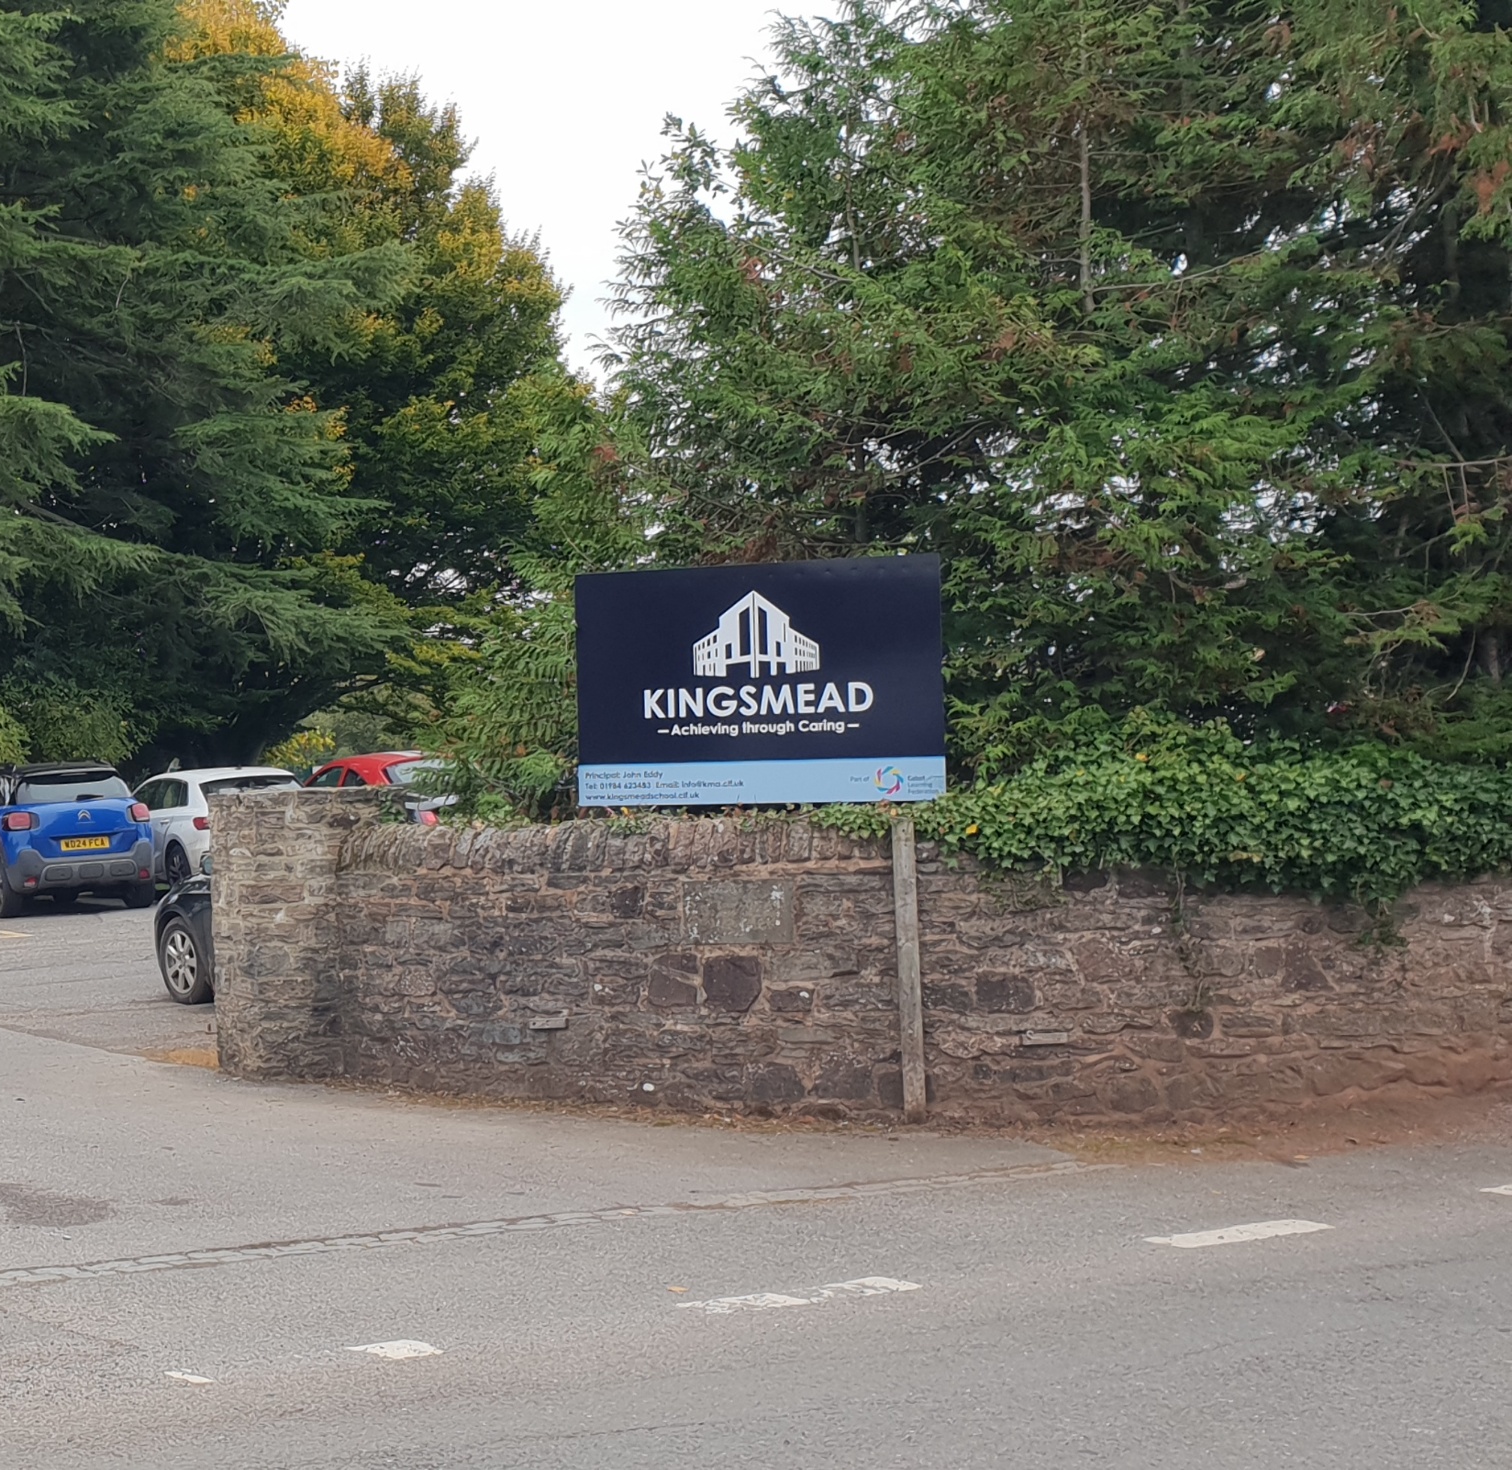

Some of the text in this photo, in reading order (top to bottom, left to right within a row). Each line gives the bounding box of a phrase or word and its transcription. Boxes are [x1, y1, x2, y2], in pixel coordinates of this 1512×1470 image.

[643, 681, 874, 719] KINGSMEAD
[670, 719, 845, 737] Achieving through Caring
[622, 771, 642, 779] John
[643, 770, 663, 780] Eddy
[88, 838, 106, 847] FCA
